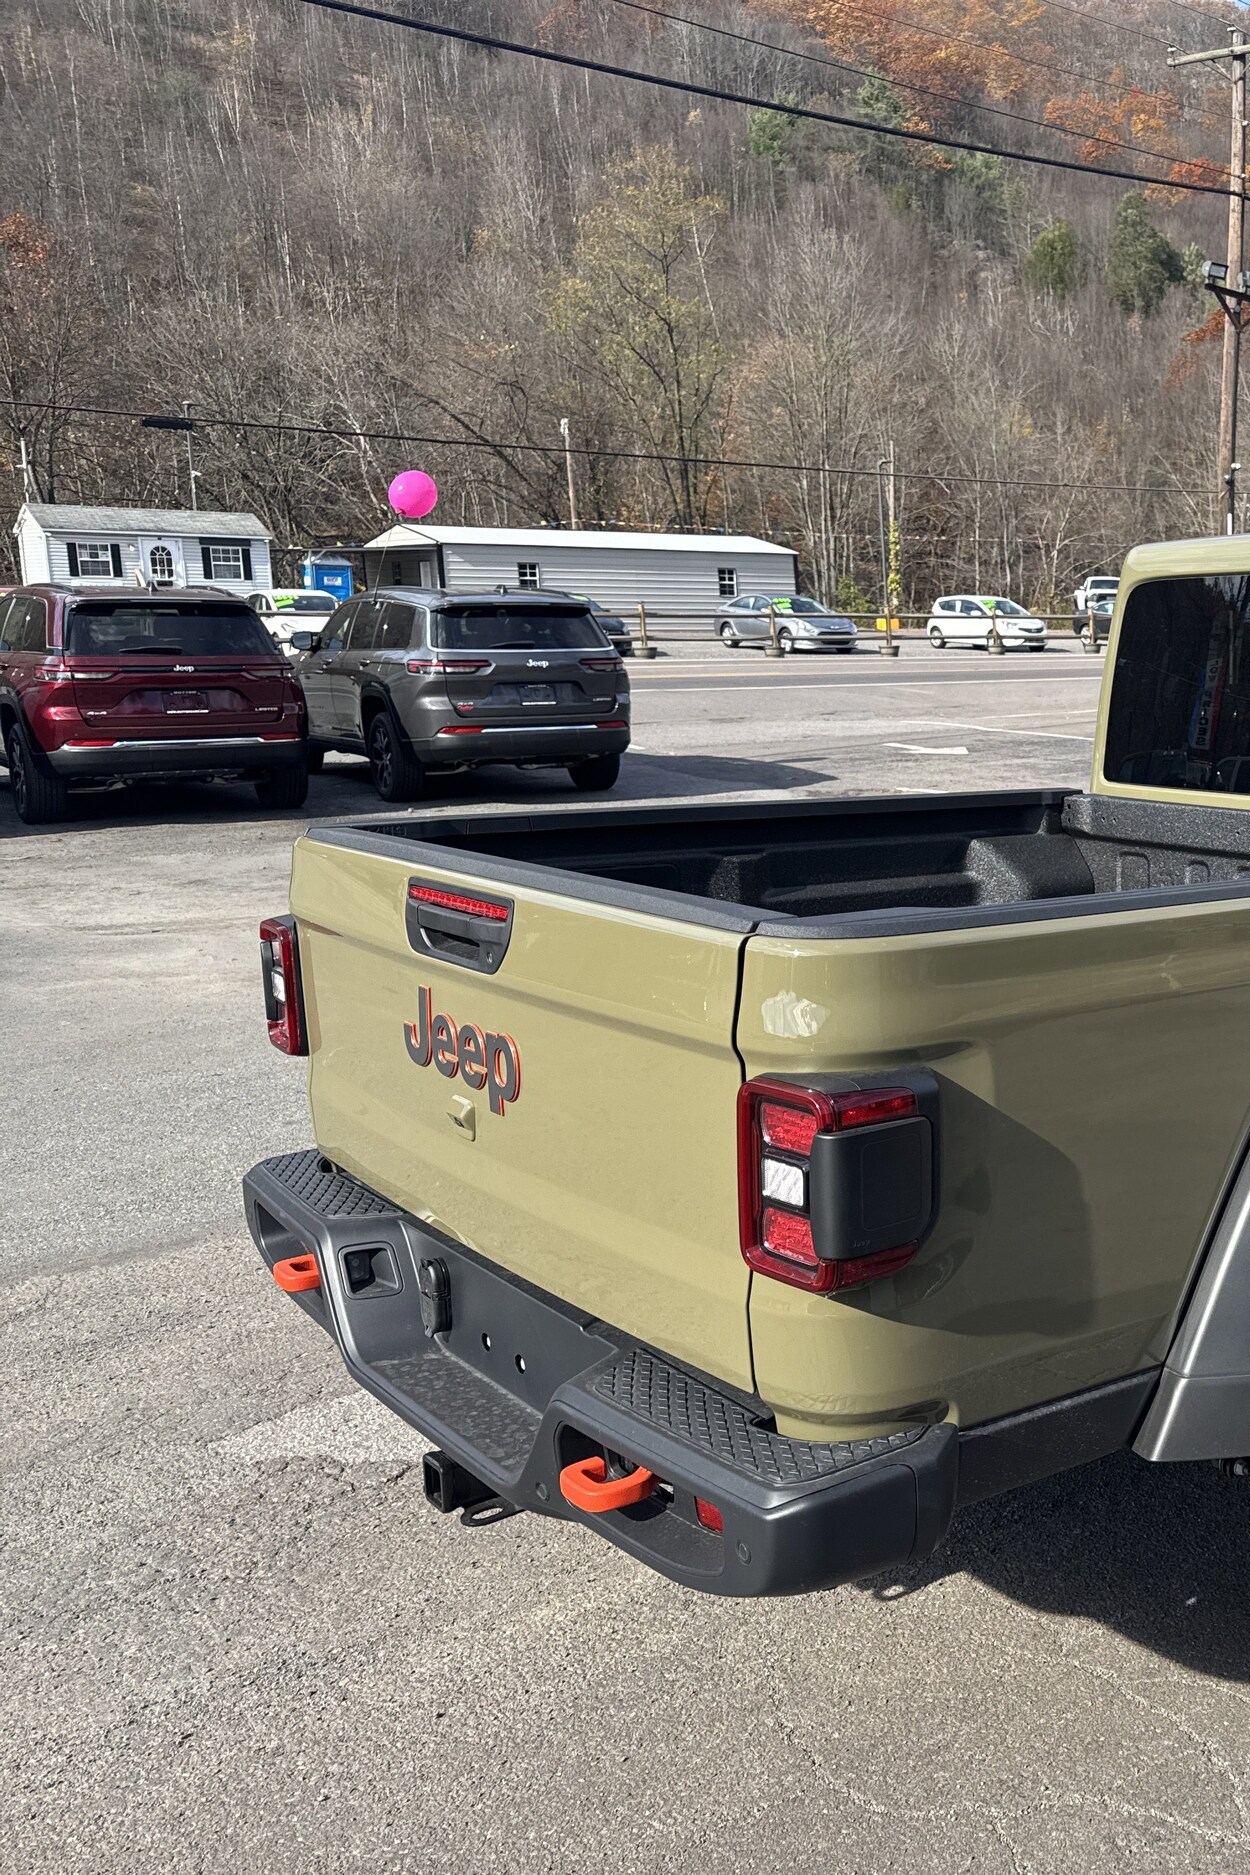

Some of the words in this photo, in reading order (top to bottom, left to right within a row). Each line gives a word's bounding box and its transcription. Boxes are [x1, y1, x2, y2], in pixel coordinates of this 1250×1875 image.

[526, 658, 549, 668] Jeep
[173, 664, 195, 673] Jeep
[403, 984, 521, 1117] Jeep
